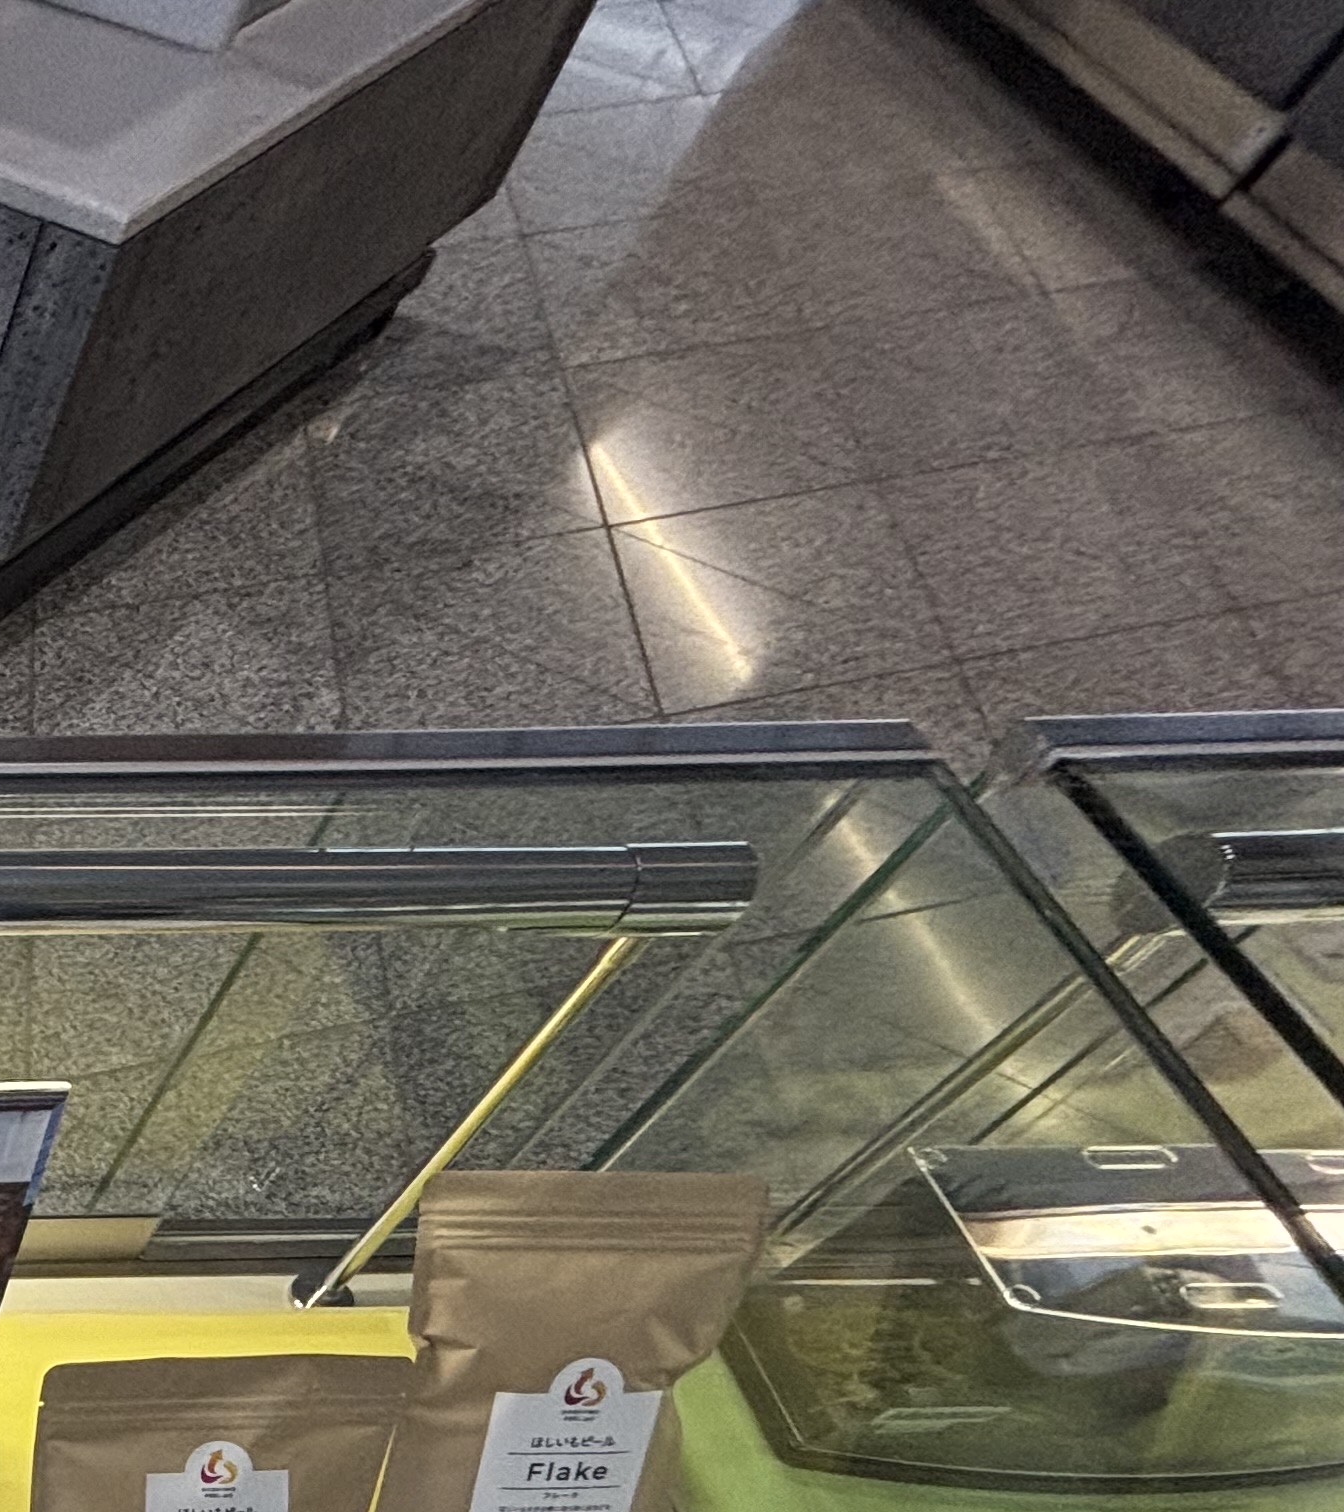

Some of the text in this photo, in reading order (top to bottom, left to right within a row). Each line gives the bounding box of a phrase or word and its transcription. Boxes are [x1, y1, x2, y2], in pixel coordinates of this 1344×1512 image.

[530, 1435, 616, 1448] ほしいもピール
[526, 1461, 609, 1482] Flake
